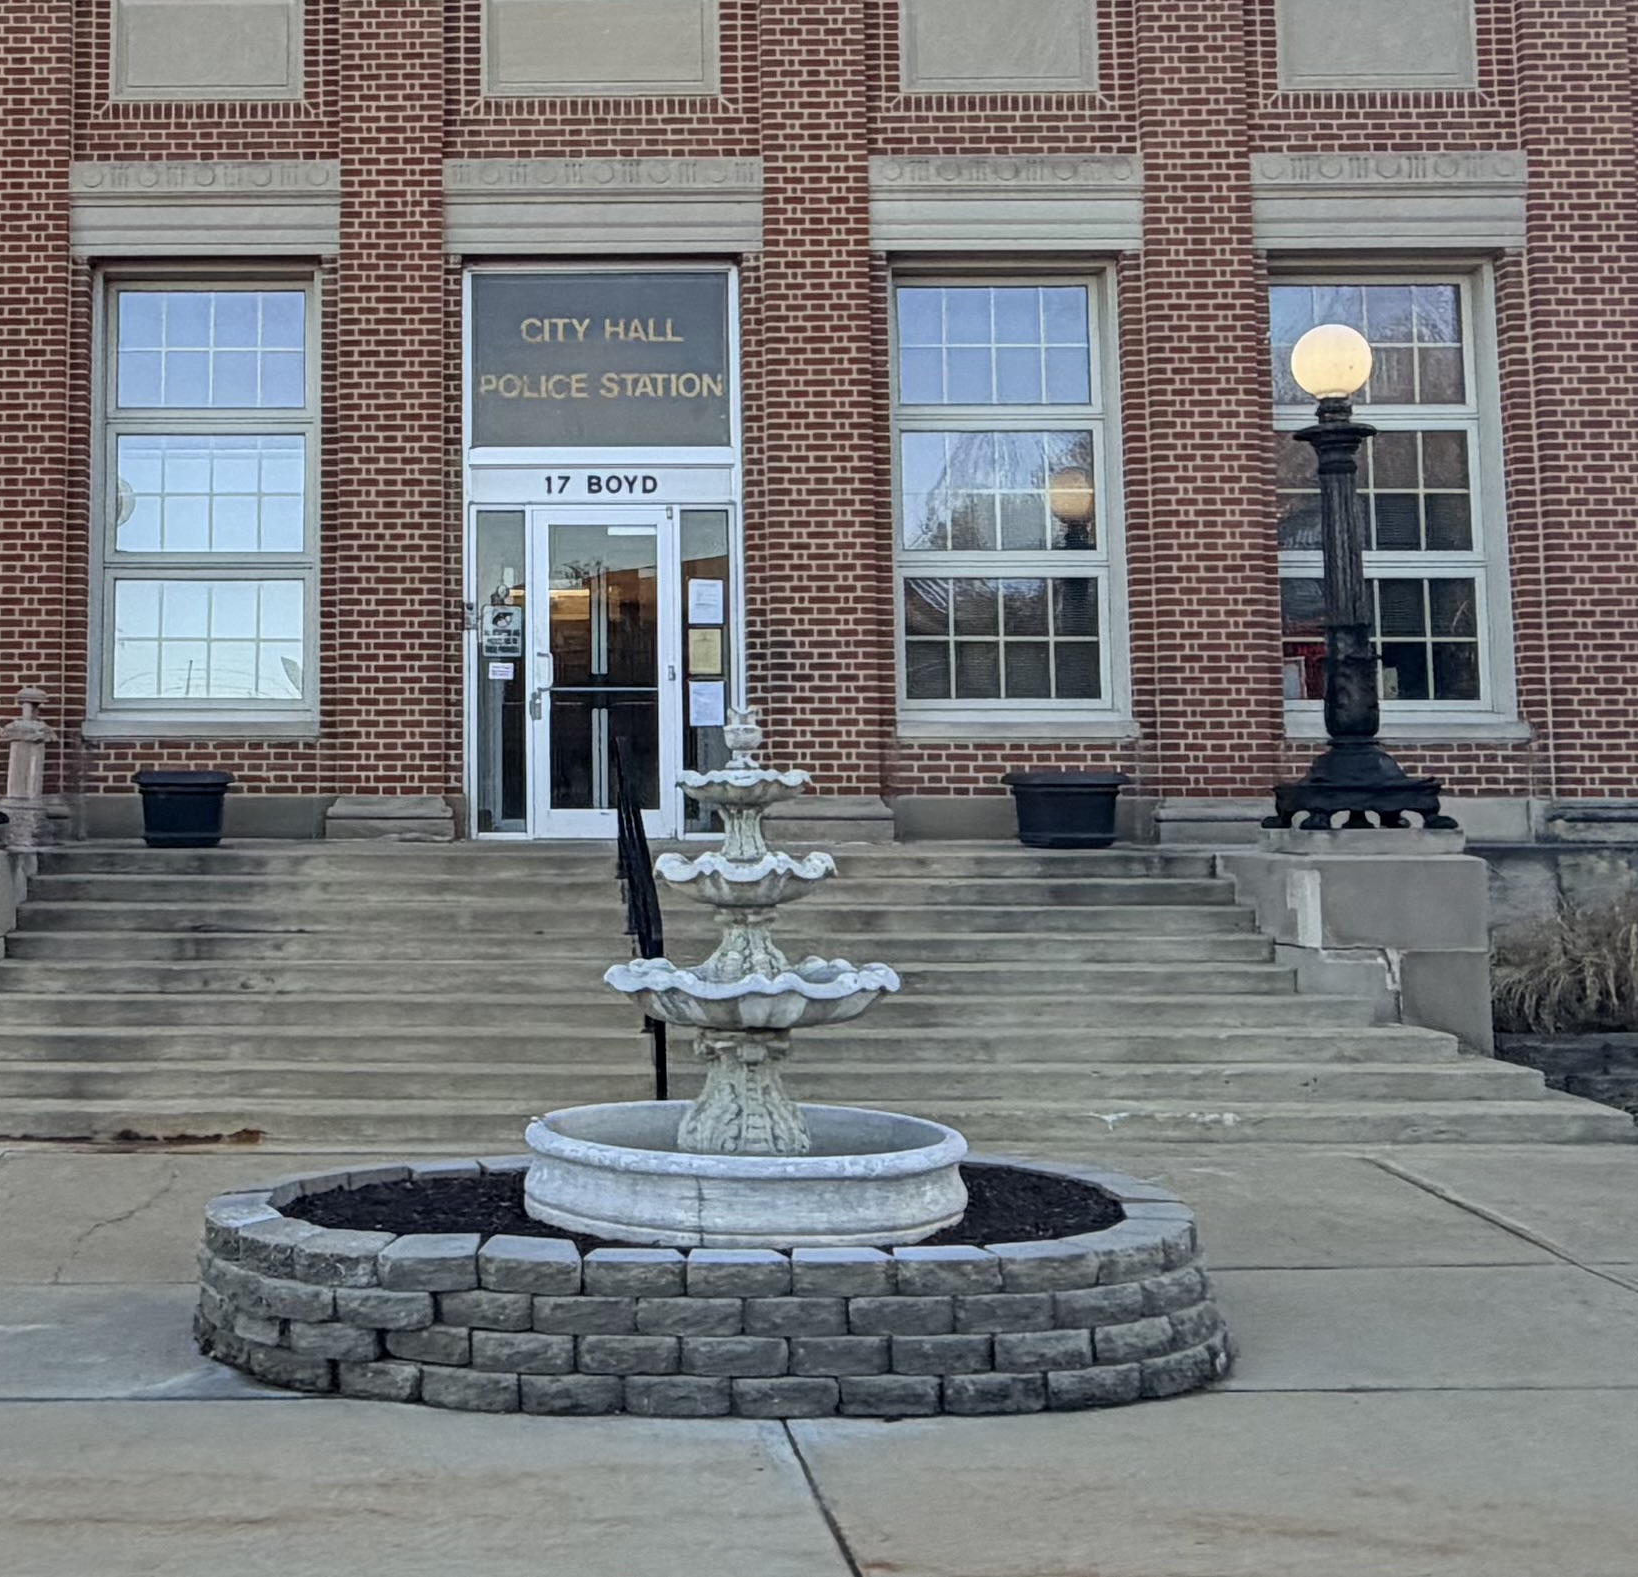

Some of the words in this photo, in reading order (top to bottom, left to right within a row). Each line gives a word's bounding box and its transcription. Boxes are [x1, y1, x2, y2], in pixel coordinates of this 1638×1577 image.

[519, 317, 591, 343] CITY
[604, 317, 685, 343] HALL
[479, 373, 590, 399] POLICE
[600, 372, 724, 398] STATION
[544, 476, 571, 495] 17
[587, 475, 658, 495] BOYD
